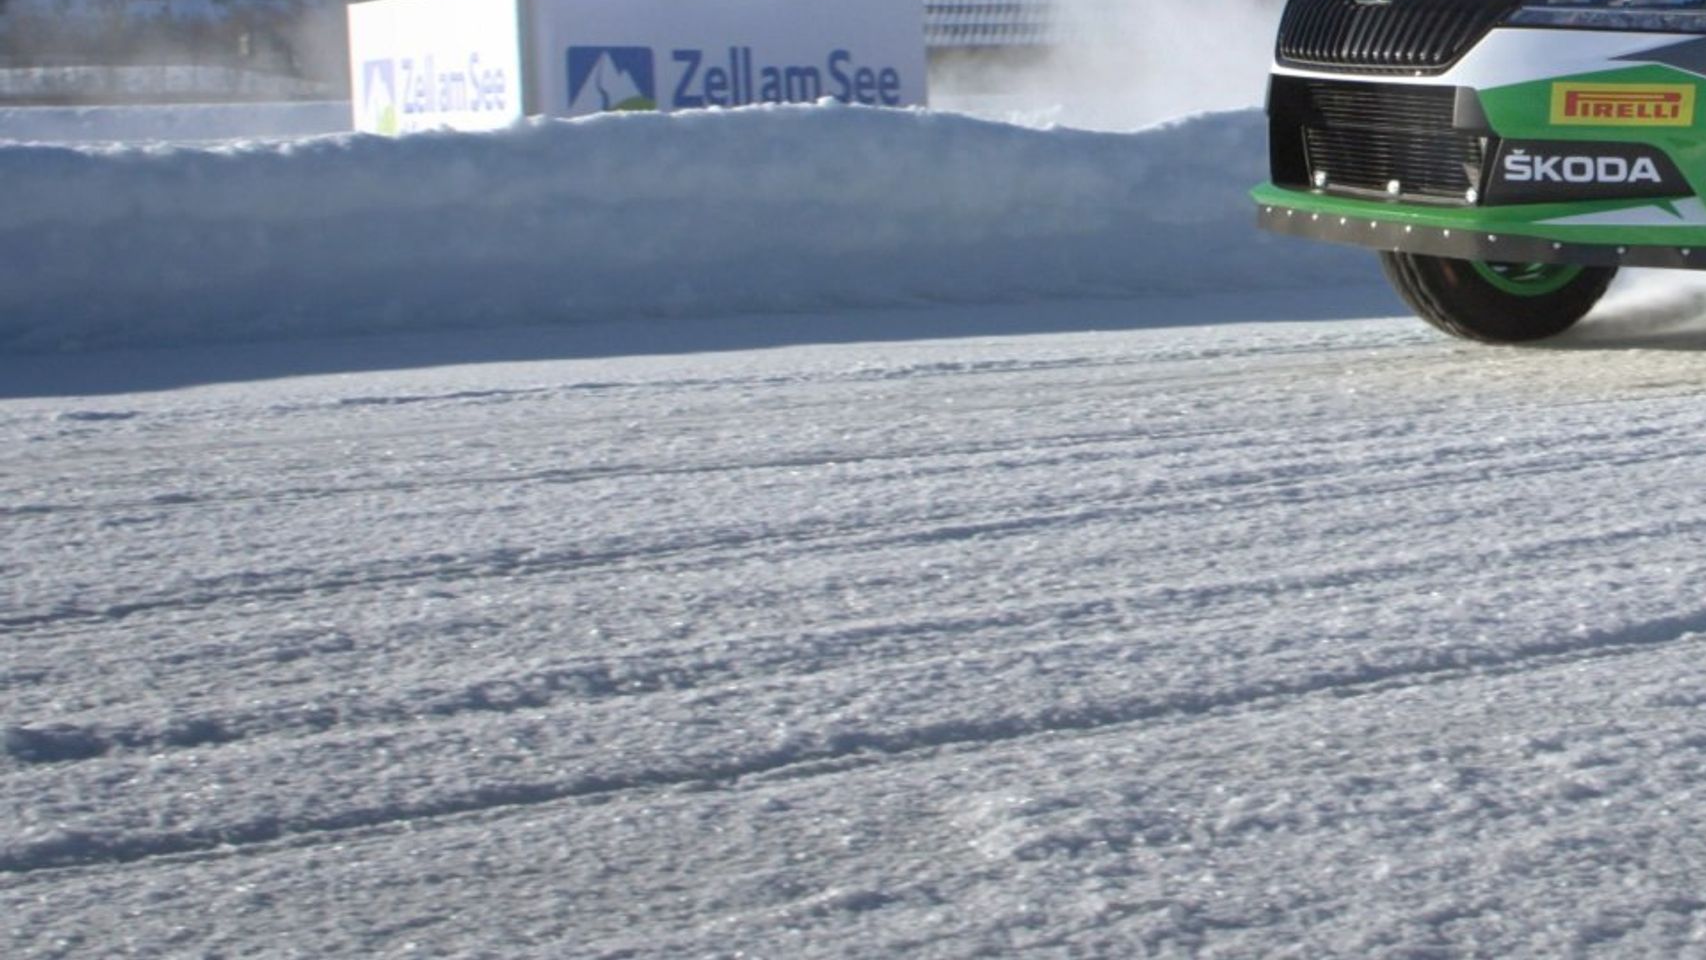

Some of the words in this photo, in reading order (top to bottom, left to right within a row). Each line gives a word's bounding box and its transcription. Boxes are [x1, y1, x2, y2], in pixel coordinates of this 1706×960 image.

[402, 54, 434, 114] Zell
[469, 51, 506, 112] See
[671, 46, 752, 108] Zell
[762, 64, 821, 103] am
[826, 48, 900, 106] See
[1564, 90, 1682, 120] PIRELLI
[1503, 148, 1662, 183] ŠKODA
